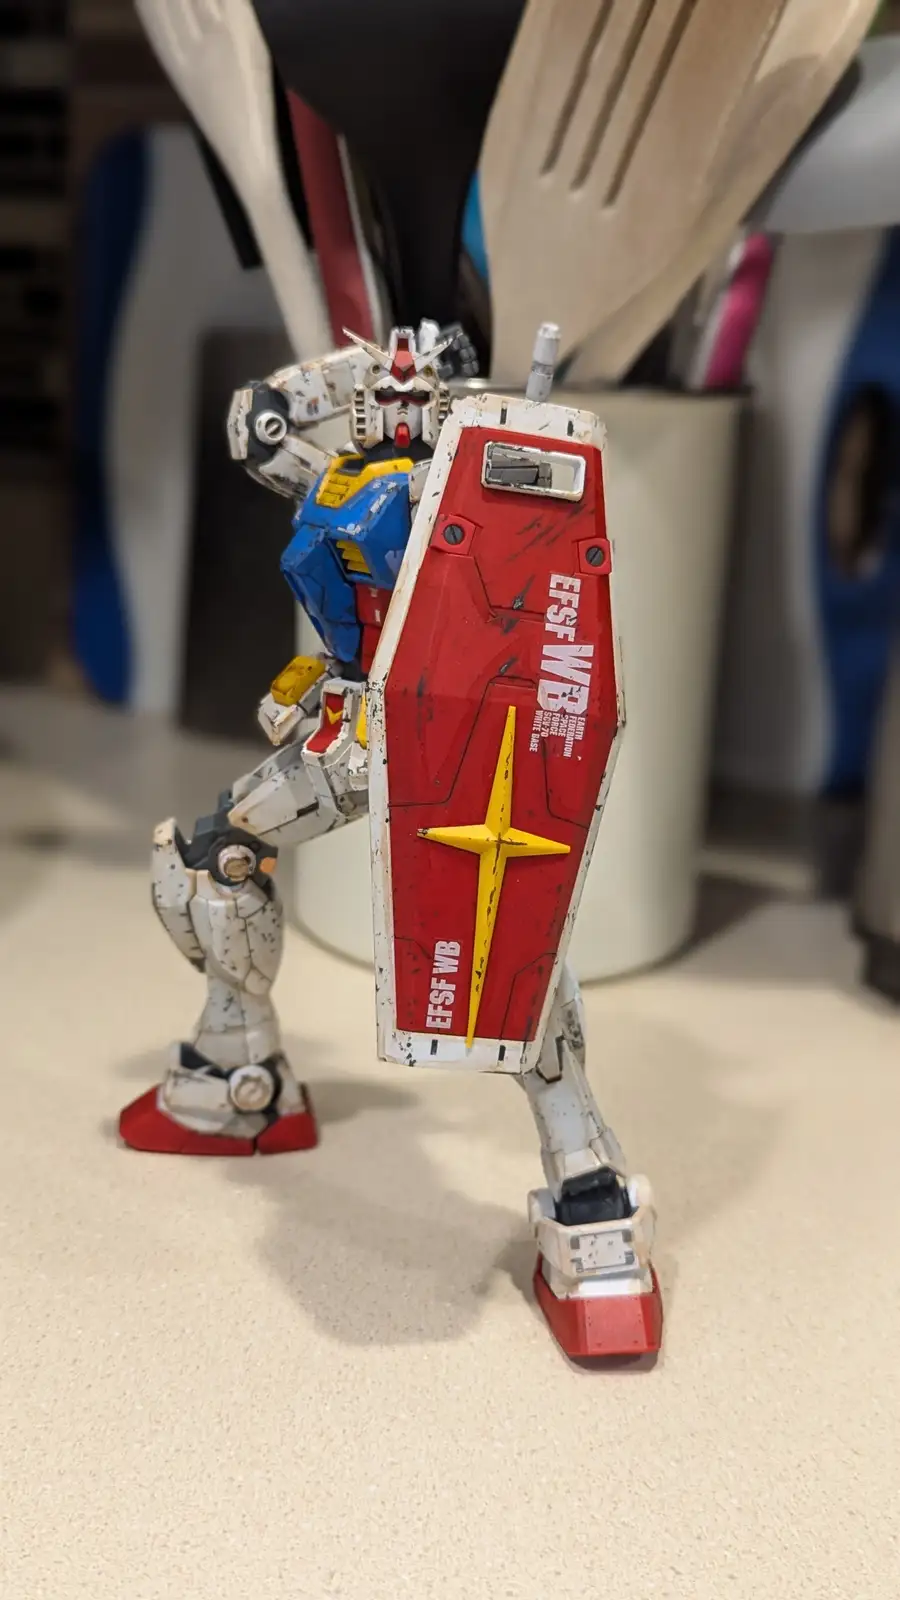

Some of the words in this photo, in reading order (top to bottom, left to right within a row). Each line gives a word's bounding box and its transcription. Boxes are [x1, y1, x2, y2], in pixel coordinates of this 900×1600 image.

[545, 573, 581, 642] EFSF
[537, 645, 594, 715] WB
[532, 710, 544, 731] WHITE
[541, 711, 551, 737] SCV-70
[550, 713, 561, 736] FORCE
[558, 714, 569, 737] SPACE
[574, 717, 586, 740] EARTH
[529, 733, 540, 752] BASE
[563, 715, 577, 757] FEDERATION
[432, 940, 461, 974] WB
[426, 977, 456, 1029] EFSF
